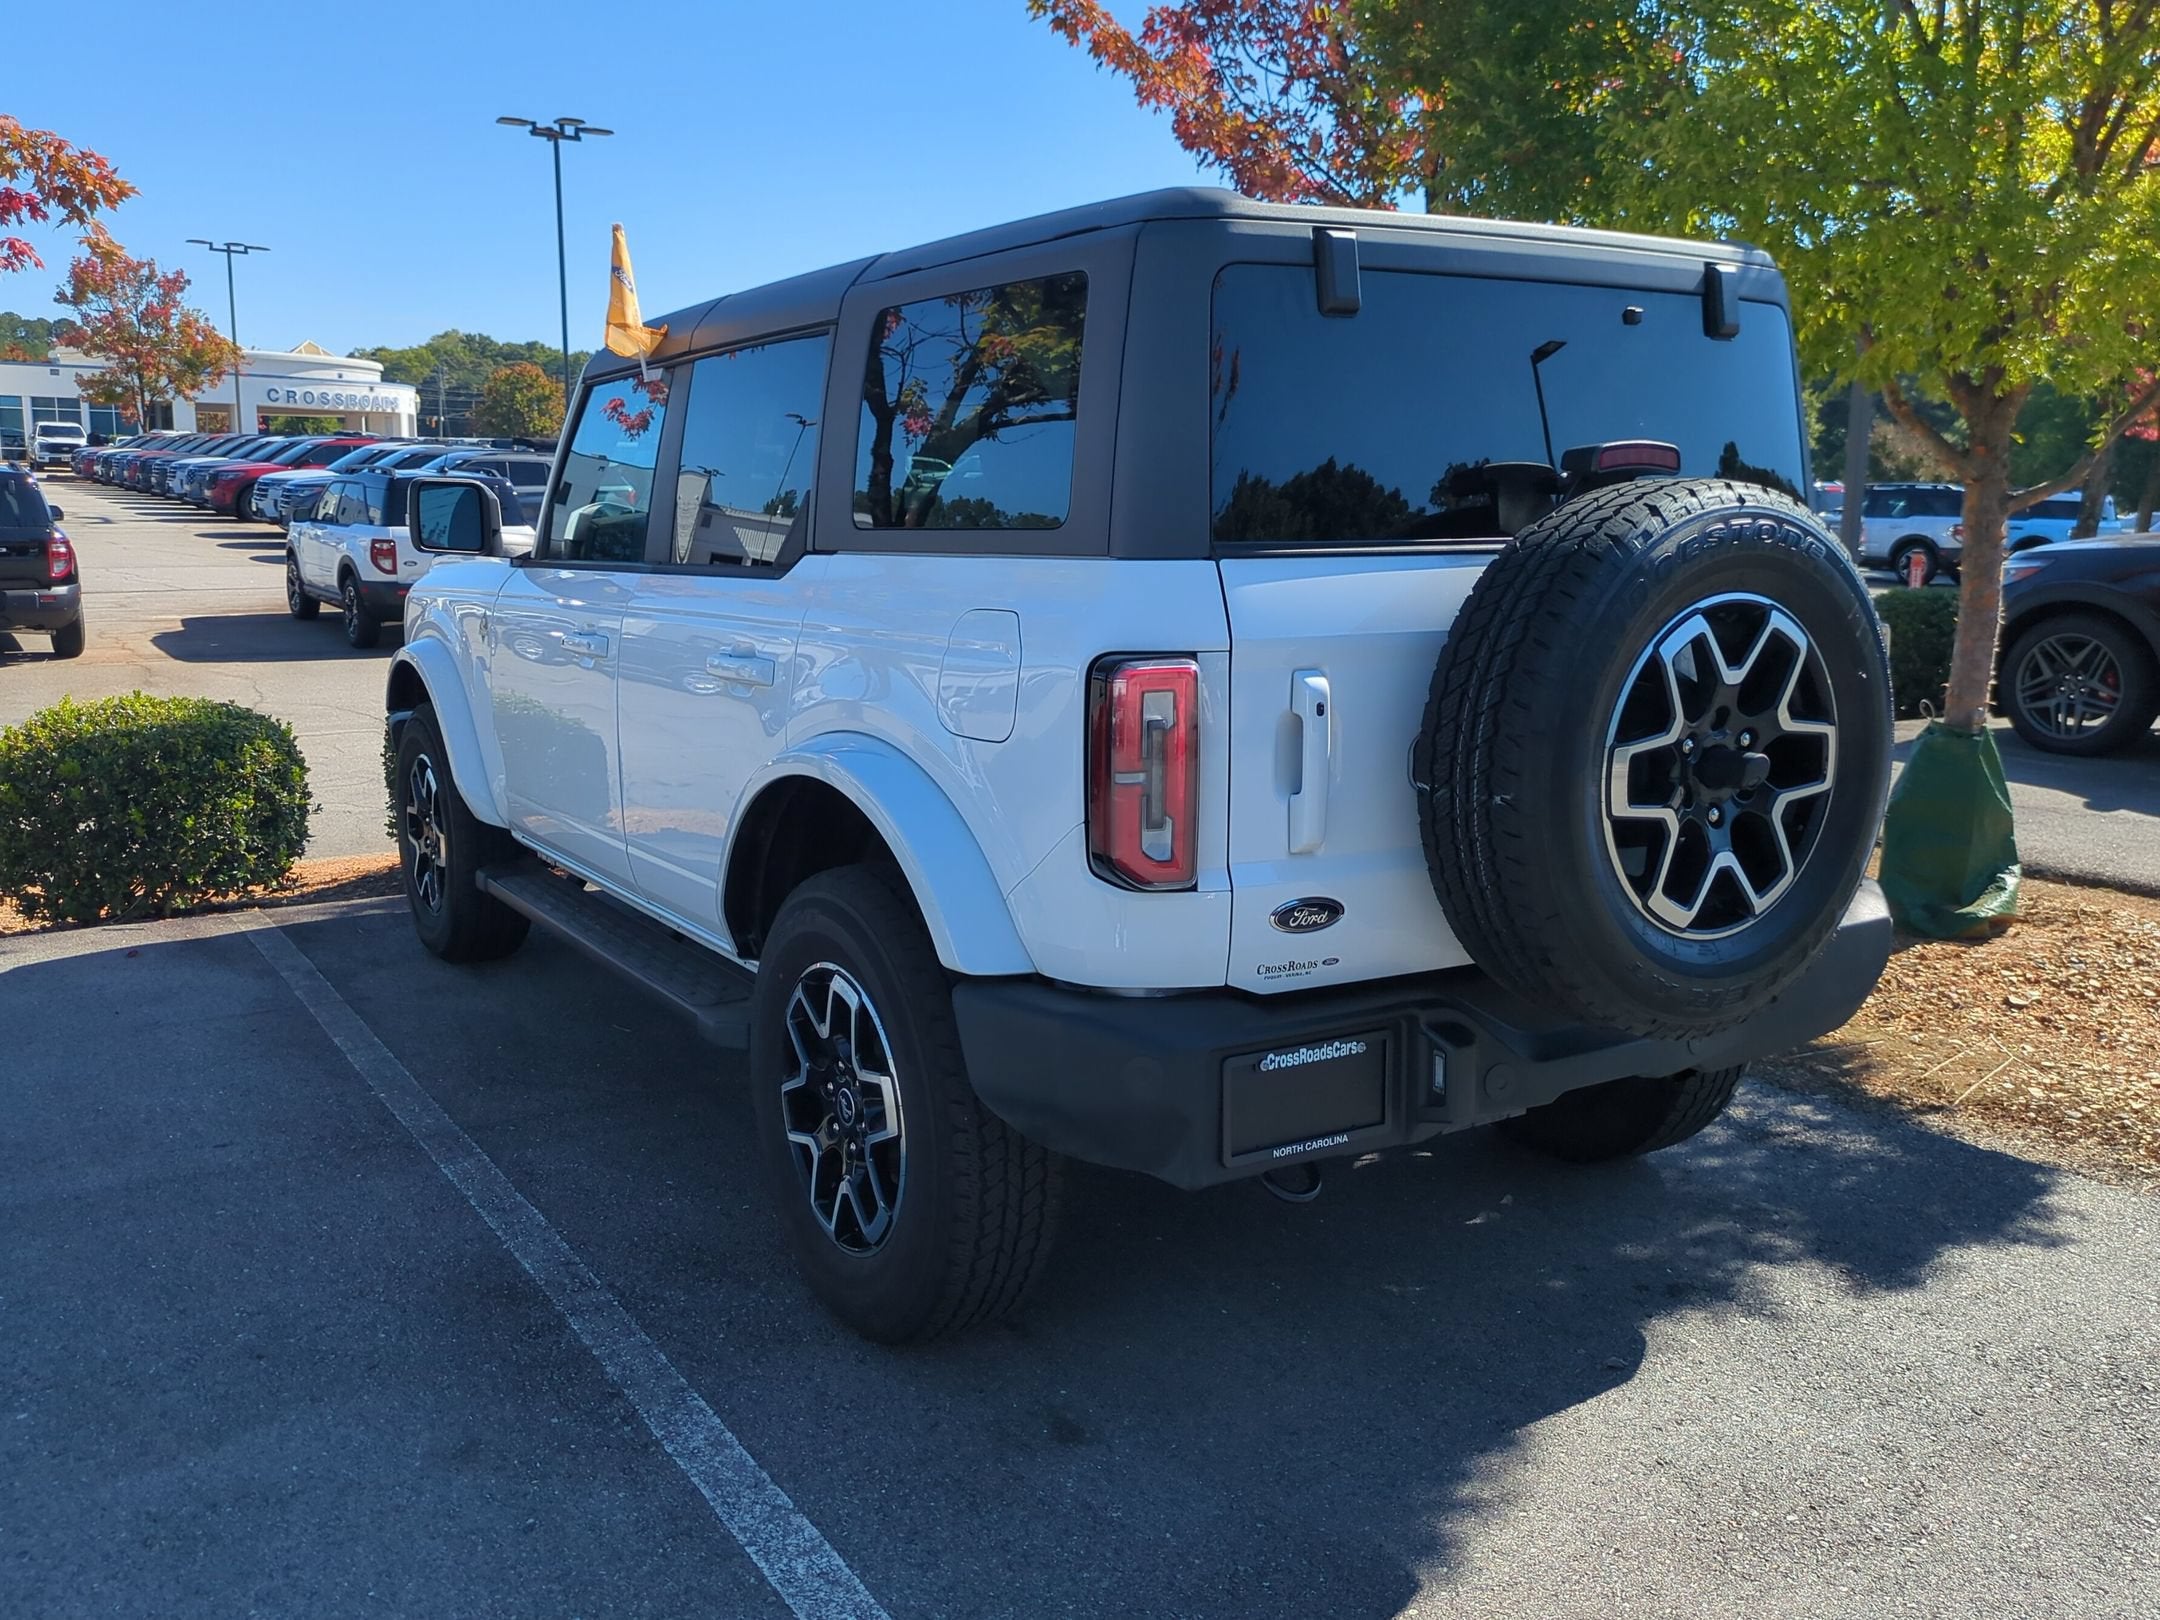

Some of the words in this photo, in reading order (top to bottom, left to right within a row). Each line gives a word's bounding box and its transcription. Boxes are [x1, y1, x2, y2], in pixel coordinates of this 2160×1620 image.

[1289, 906, 1329, 927] Ford
[1267, 1041, 1357, 1070] CrossRoadsCars
[1273, 1143, 1304, 1159] NORTH
[1305, 1134, 1349, 1151] CAROLINA
